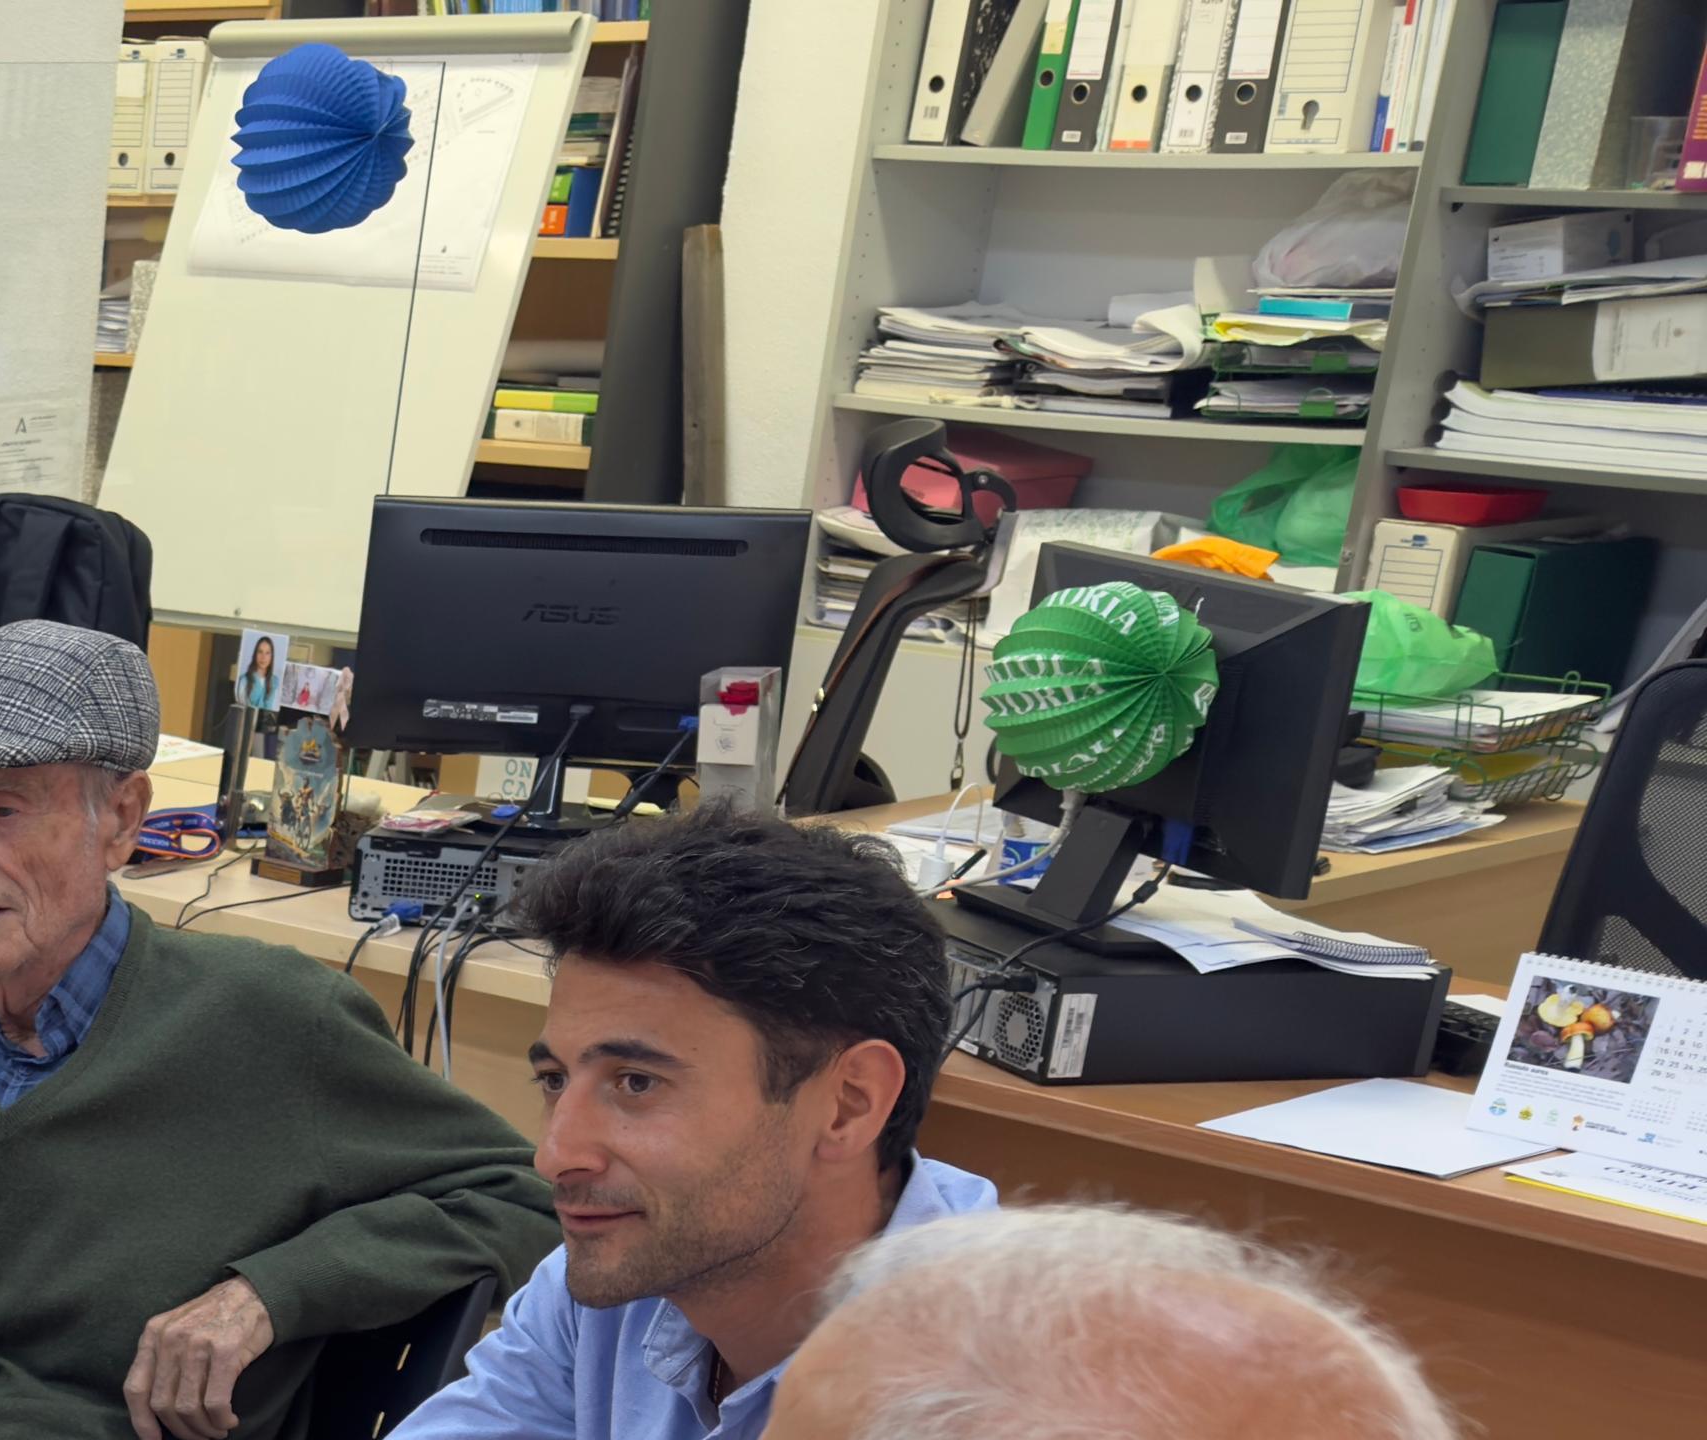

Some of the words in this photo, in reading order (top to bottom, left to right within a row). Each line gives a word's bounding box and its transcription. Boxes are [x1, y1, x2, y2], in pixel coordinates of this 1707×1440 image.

[522, 603, 620, 626] ASUS
[504, 758, 532, 779] ON
[502, 779, 528, 798] CA
